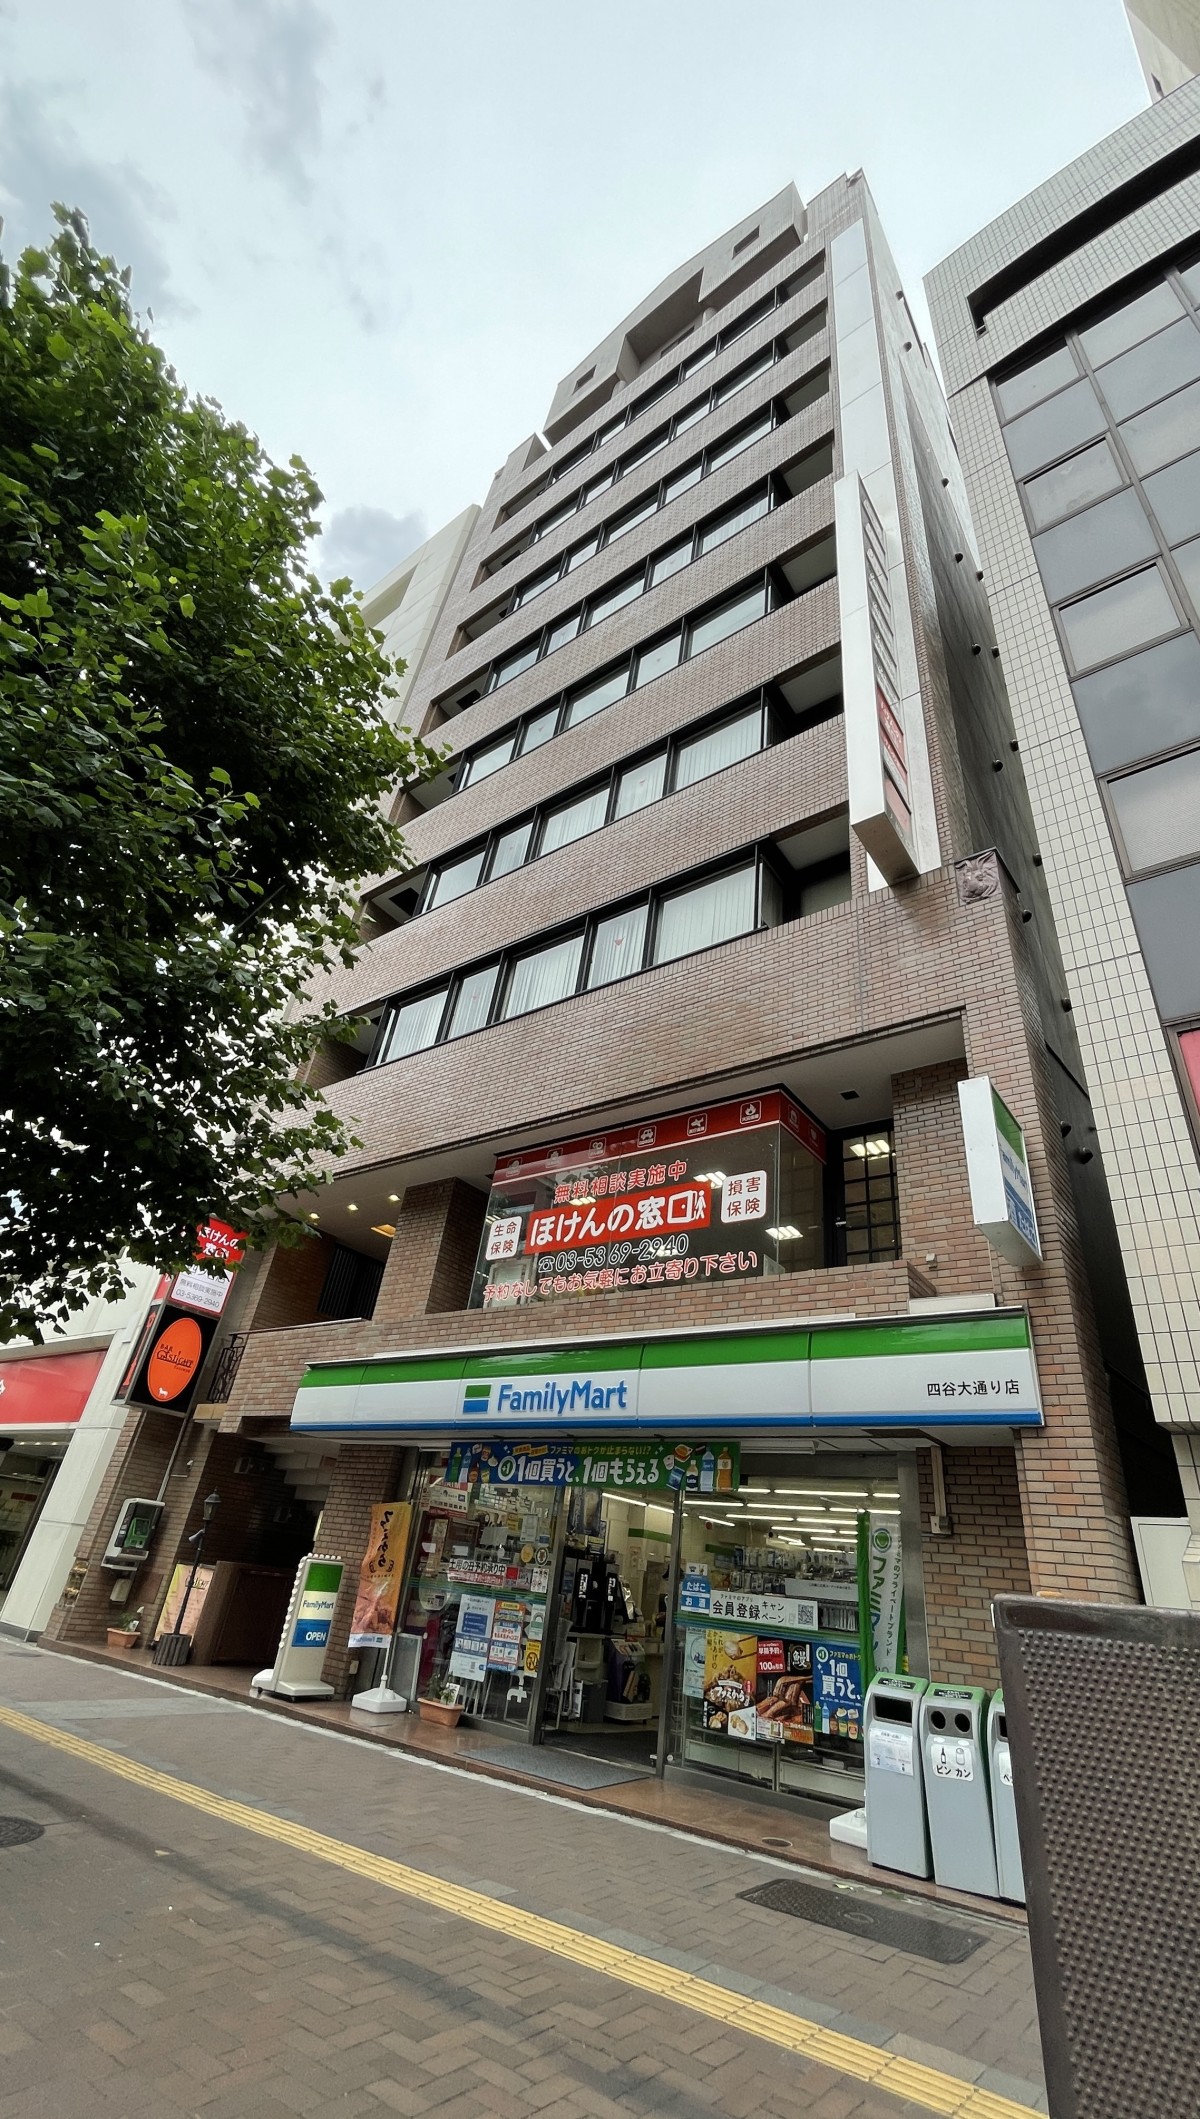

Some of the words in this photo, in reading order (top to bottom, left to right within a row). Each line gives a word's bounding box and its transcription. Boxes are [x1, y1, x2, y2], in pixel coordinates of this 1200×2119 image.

[553, 1160, 688, 1204] 無料相談実施中
[727, 1176, 761, 1197] 損害
[727, 1197, 761, 1217] 保険
[530, 1189, 693, 1248] ほけんの窓口
[494, 1221, 517, 1238] 生命
[490, 1239, 514, 1256] 保険
[483, 1250, 759, 1303] 予約なしでもお気軽にお立寄り下さい
[927, 1379, 1020, 1396] 四谷大通り店
[498, 1380, 627, 1415] FamilyMart
[517, 1456, 660, 1485] 1個買うと、1個もらえる
[686, 1581, 707, 1593] たばこ
[303, 1600, 334, 1610] FamilyMart
[712, 1600, 761, 1621] 会員登録
[761, 1601, 785, 1612] キャン
[761, 1614, 785, 1624] ペーン
[305, 1631, 327, 1642] OPEN
[829, 1659, 848, 1677] 1個
[822, 1675, 861, 1700] 買うと、
[956, 1769, 971, 1778] カン
